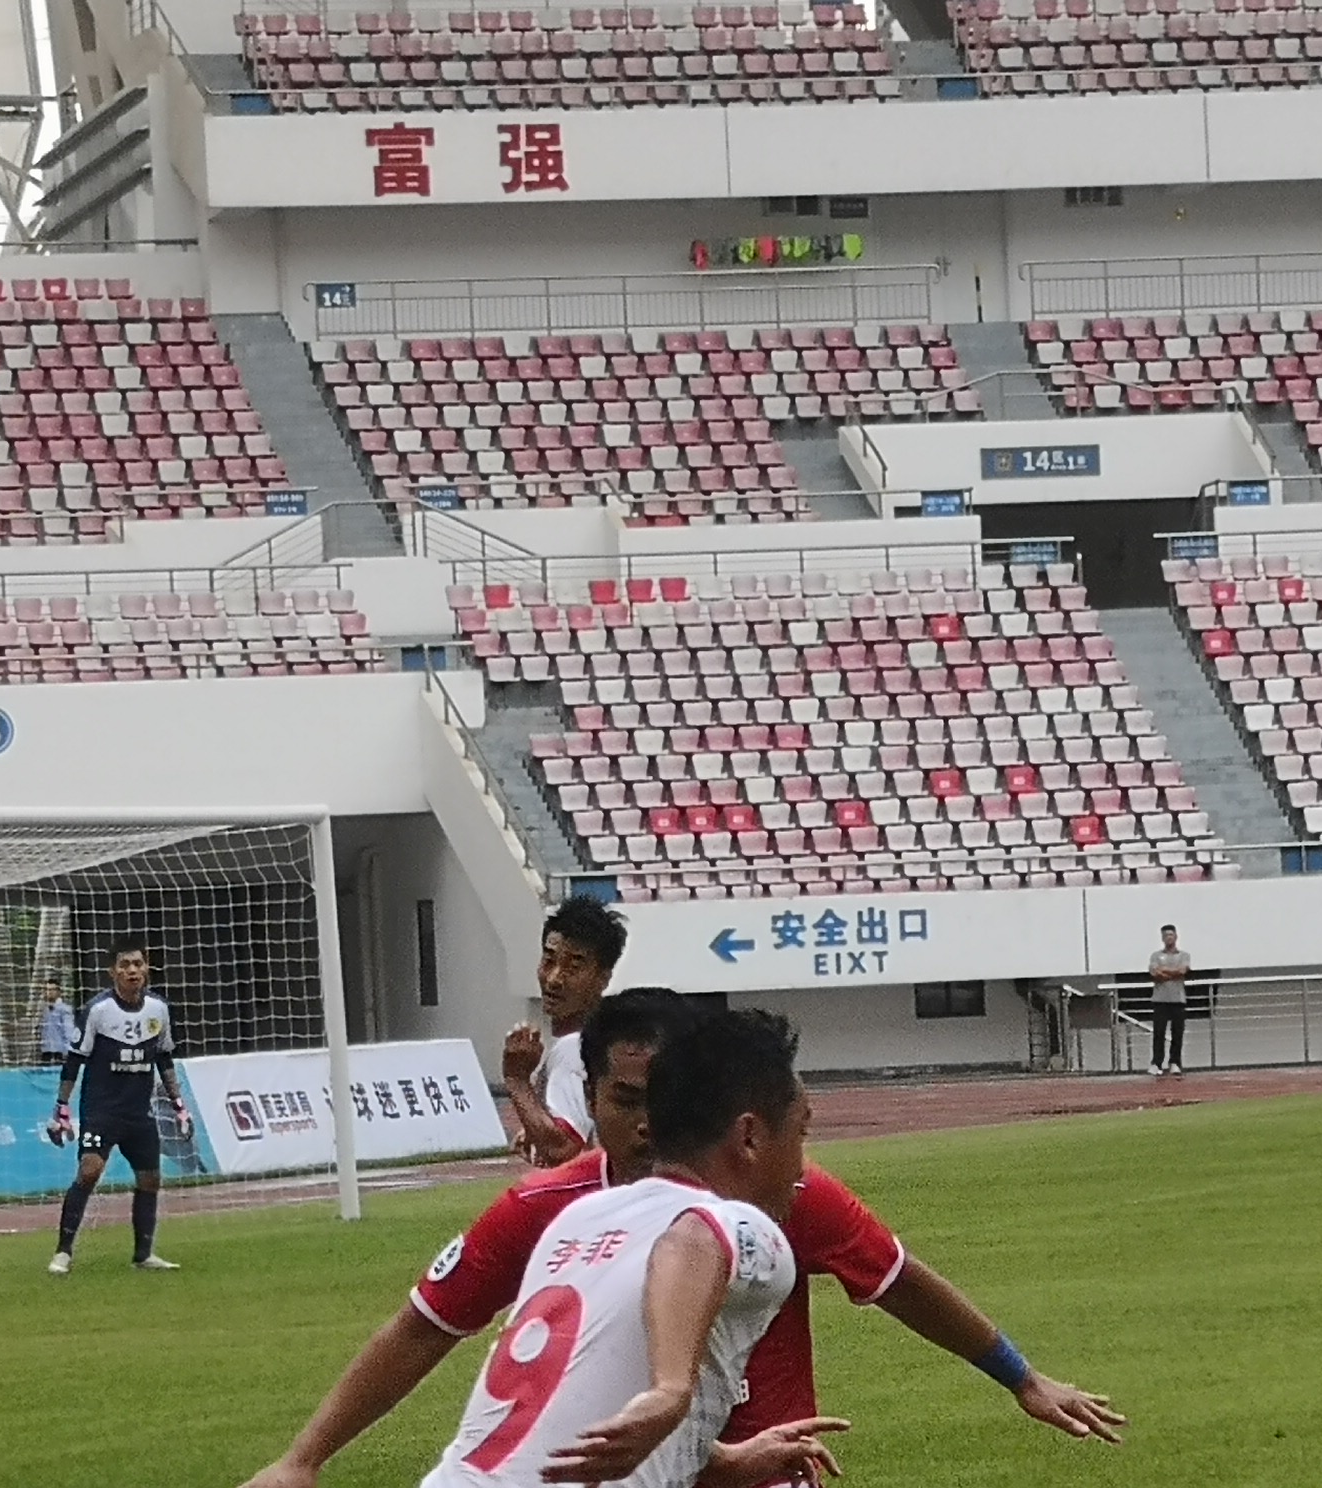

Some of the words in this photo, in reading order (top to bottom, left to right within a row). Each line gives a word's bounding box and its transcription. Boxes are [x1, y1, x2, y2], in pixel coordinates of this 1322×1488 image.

[364, 121, 570, 197] 富强
[770, 906, 929, 950] 安全出口
[813, 950, 890, 976] EIXT
[460, 1284, 584, 1473] 9
